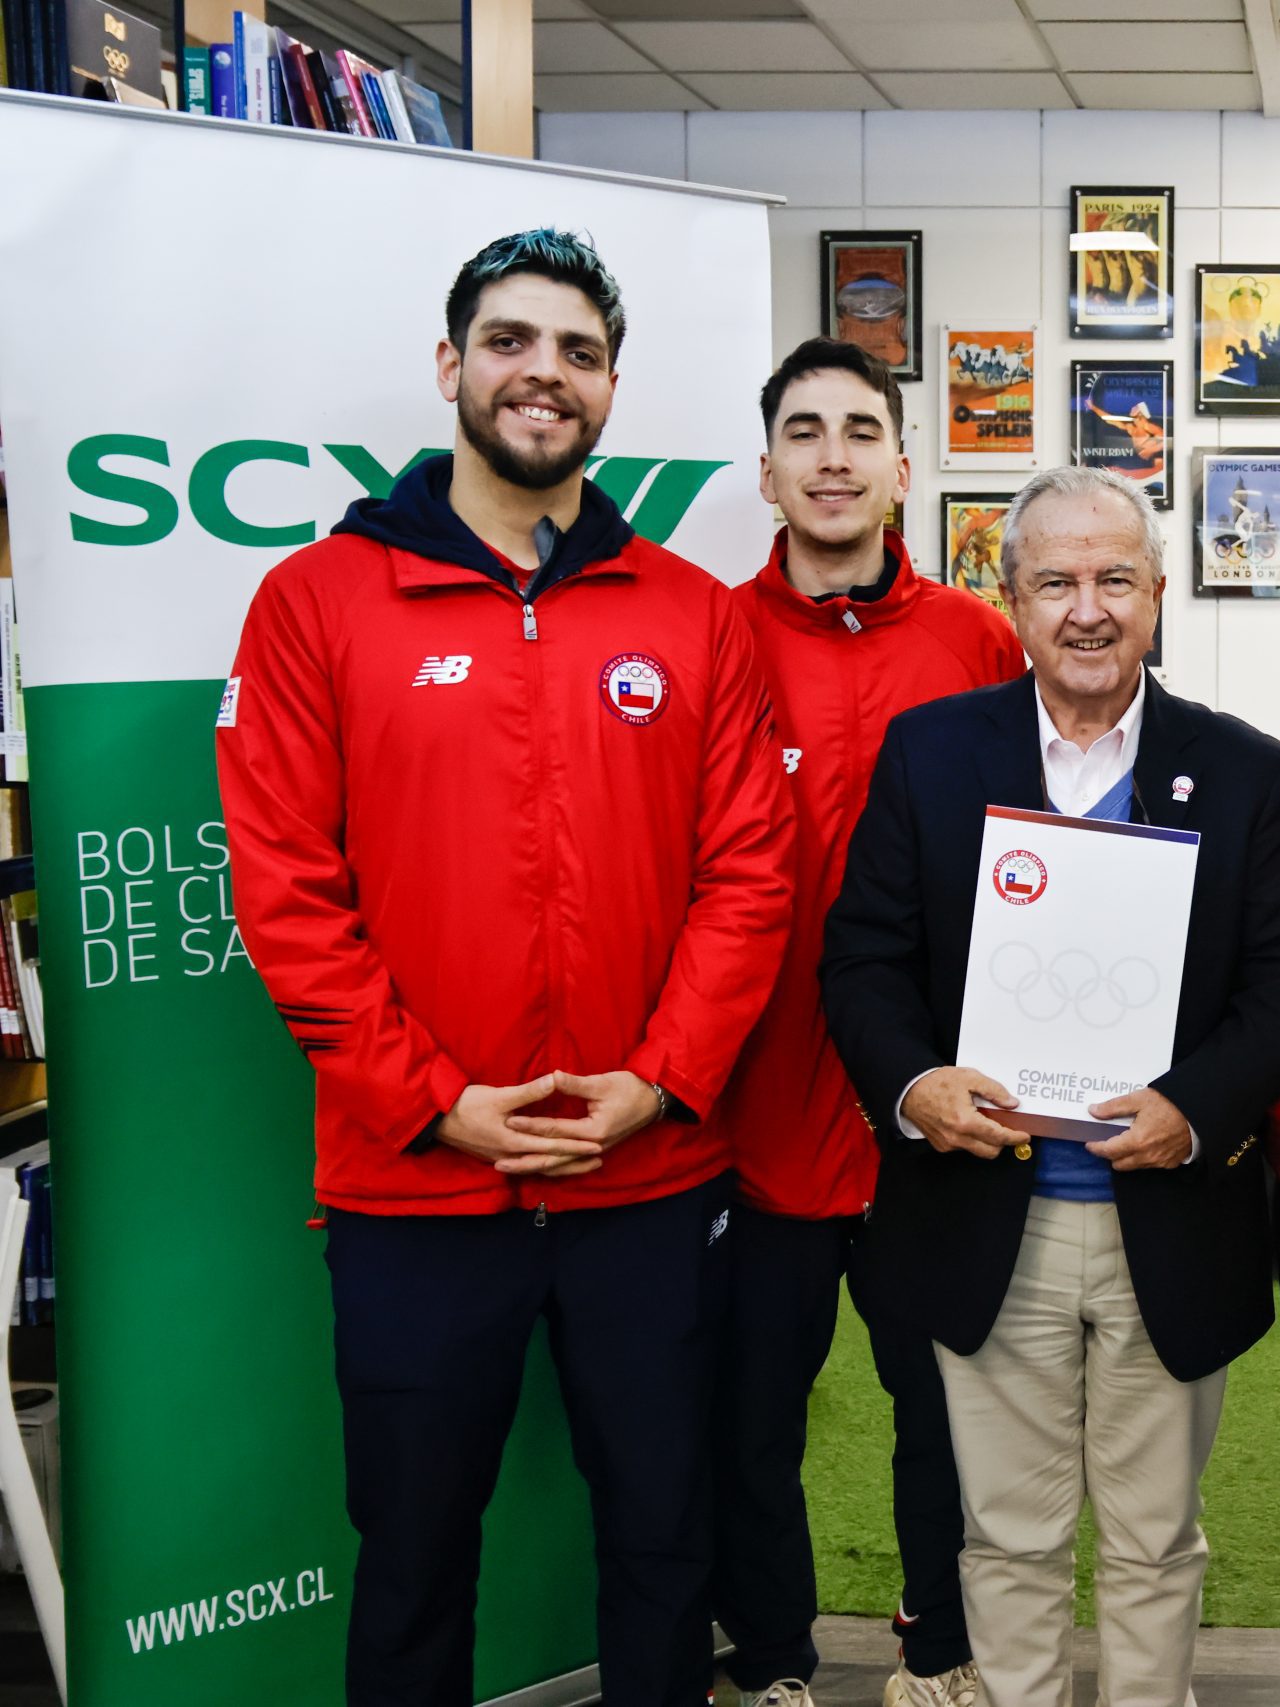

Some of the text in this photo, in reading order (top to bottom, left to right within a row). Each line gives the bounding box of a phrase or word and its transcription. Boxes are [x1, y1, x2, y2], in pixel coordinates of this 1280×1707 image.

[1085, 204, 1160, 212] PARIS 1924
[995, 394, 1031, 410] 1916
[976, 423, 1032, 438] SPELEN
[1083, 447, 1134, 457] AMSTERDAM
[1208, 463, 1249, 473] OLYMPIC
[1213, 570, 1276, 578] LONDON
[621, 713, 651, 724] CHILE
[77, 821, 231, 881] BOLS
[80, 879, 156, 935] DE
[1004, 895, 1030, 905] CHILE
[84, 932, 160, 989] DE
[1018, 1068, 1144, 1094] COMITÉ OLÍMPIC
[1017, 1083, 1086, 1103] DE CHILE
[125, 1566, 335, 1655] WWW.SCX.CL
